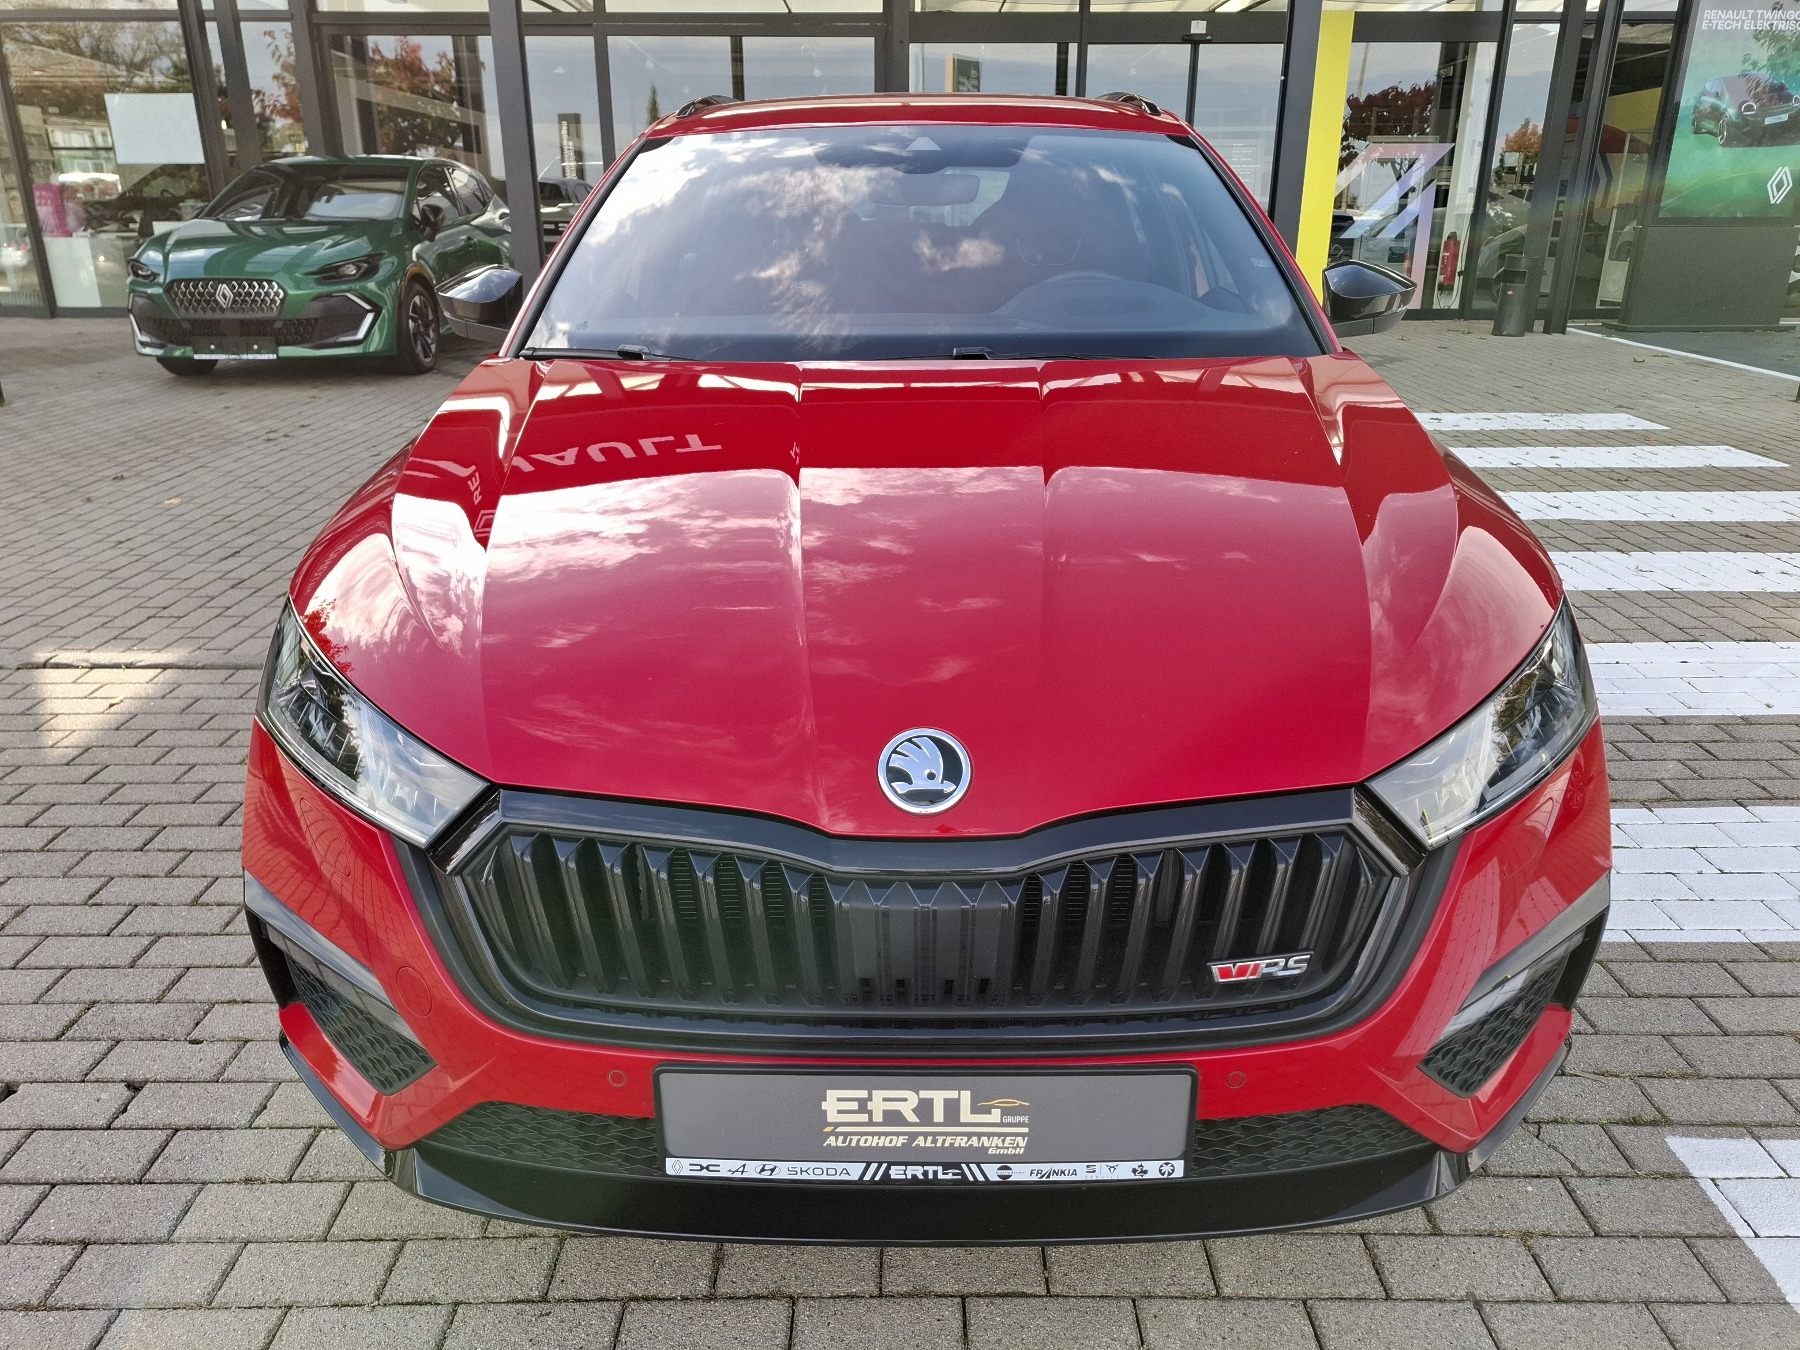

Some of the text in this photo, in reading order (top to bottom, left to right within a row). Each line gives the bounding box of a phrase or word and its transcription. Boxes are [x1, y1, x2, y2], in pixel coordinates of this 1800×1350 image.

[1703, 9, 1755, 20] RENAULT
[1702, 20, 1742, 30] E-TECH
[821, 1089, 1001, 1123] ERTL
[1002, 1115, 1030, 1124] GRUPPE
[823, 1135, 1029, 1148] AUTOHOF ALTFRANKEN
[988, 1147, 1025, 1155] GmbH
[889, 1165, 961, 1180] ERTL
[1029, 1167, 1078, 1180] FRANKIA
